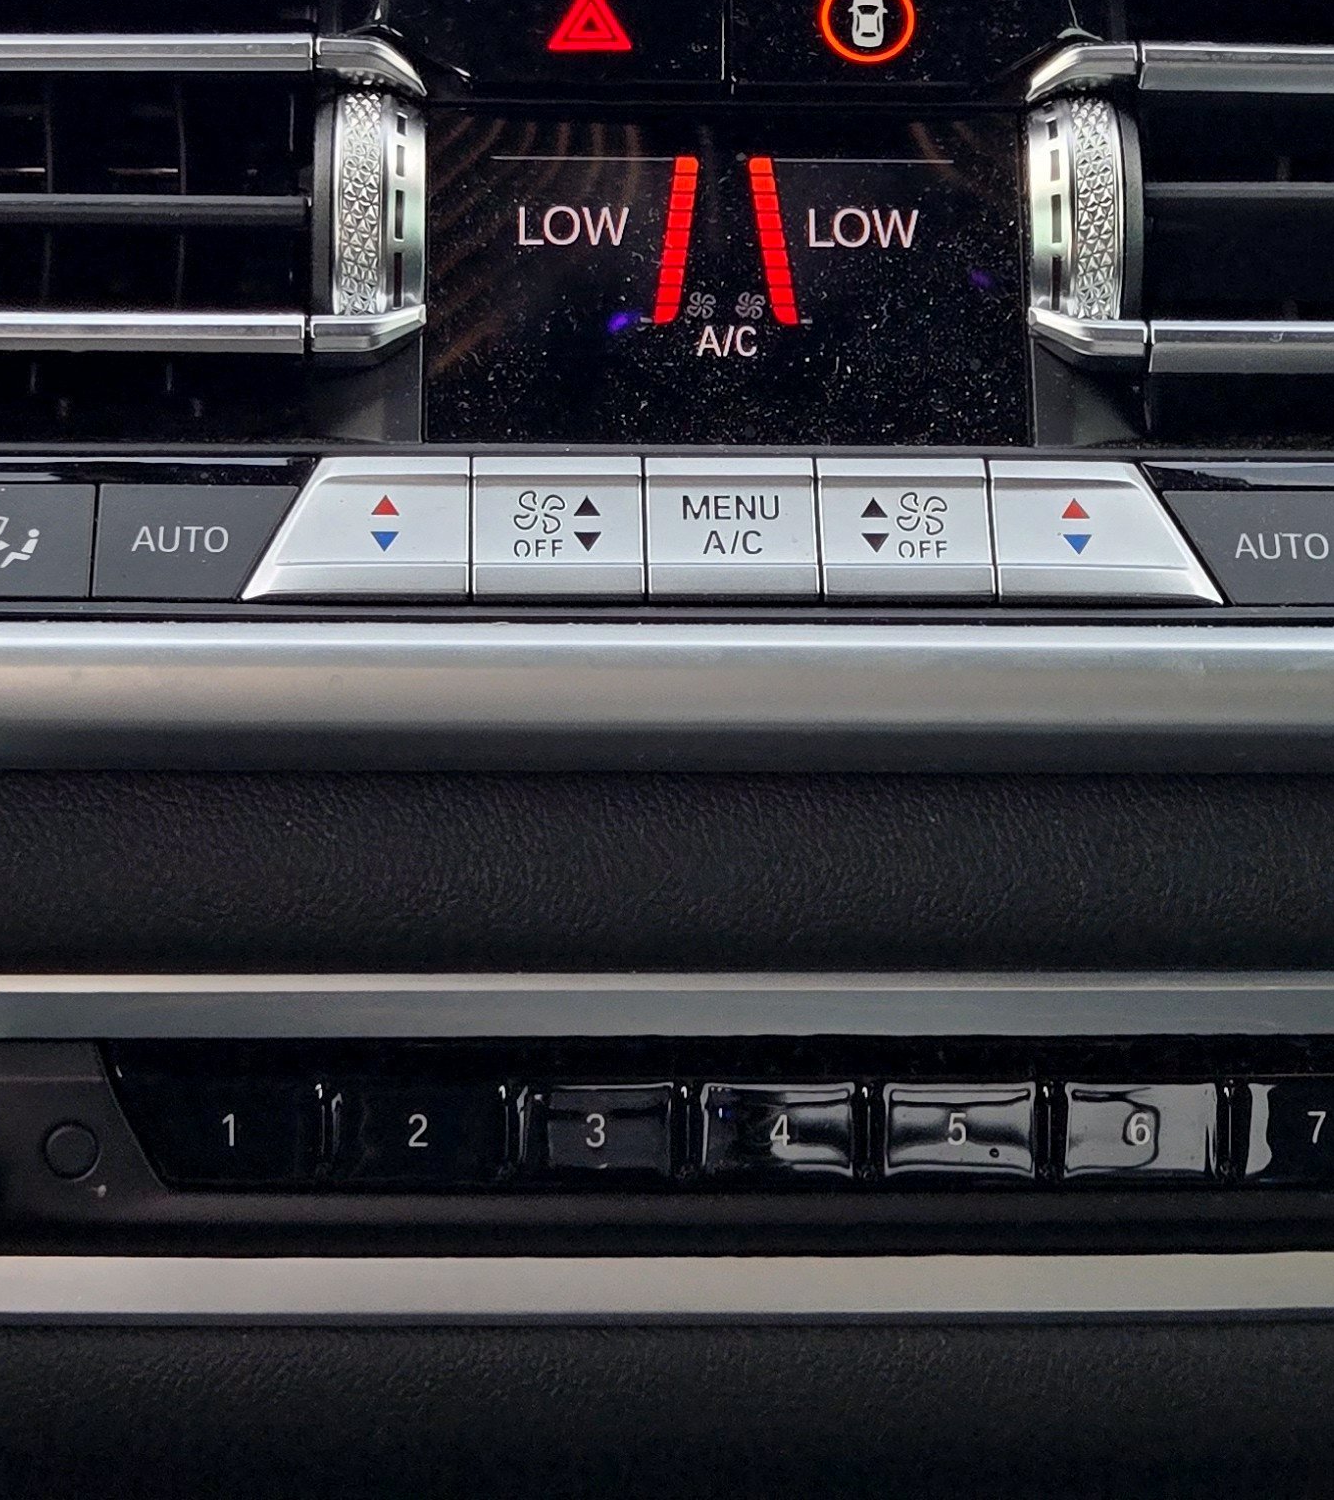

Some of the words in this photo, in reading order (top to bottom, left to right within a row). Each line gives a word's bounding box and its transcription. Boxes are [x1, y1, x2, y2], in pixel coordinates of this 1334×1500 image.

[518, 206, 630, 247] LOW
[808, 208, 919, 249] LOW
[696, 325, 757, 357] A/C
[682, 495, 780, 521] MENU
[131, 525, 229, 553] AUTO
[513, 539, 564, 558] OFF
[702, 530, 763, 556] A/C
[898, 540, 948, 559] OFF
[1235, 532, 1329, 560] AUTO
[221, 1114, 235, 1147] 1
[408, 1115, 429, 1148] 2
[586, 1115, 606, 1148] 3
[769, 1114, 791, 1148] 4
[947, 1113, 967, 1146] 5
[1130, 1112, 1151, 1145] 6
[1308, 1111, 1327, 1144] 7
